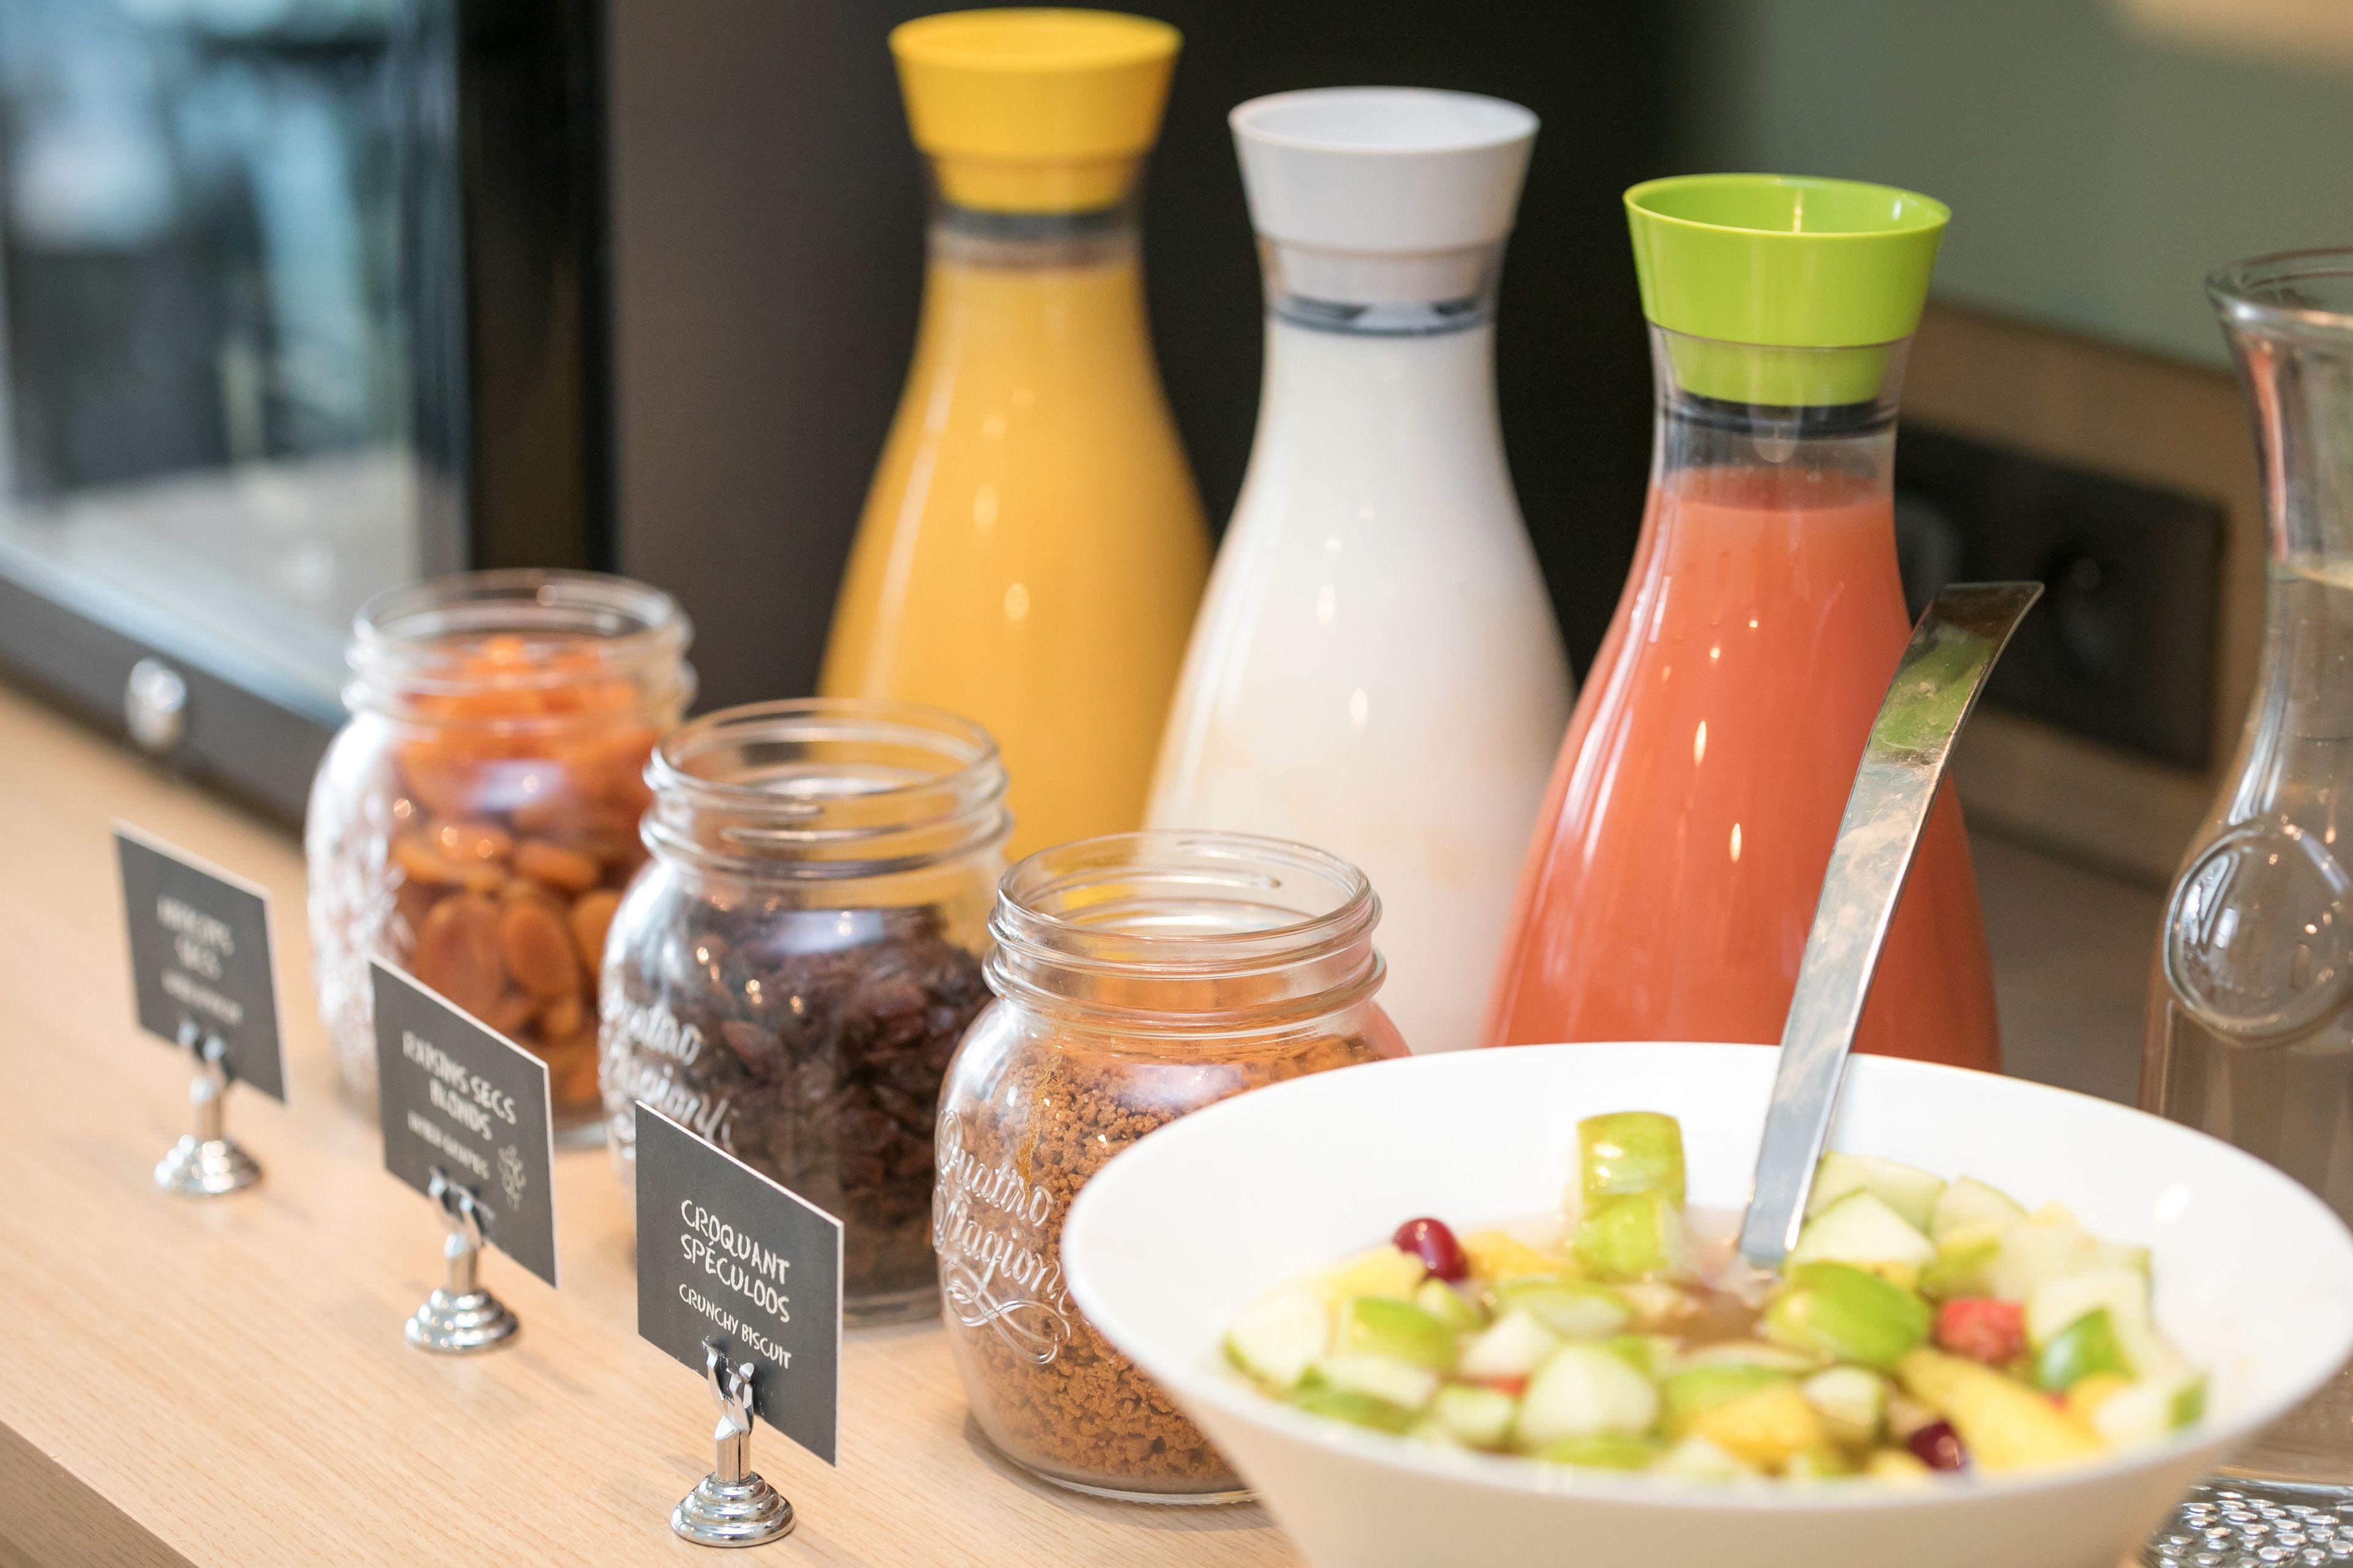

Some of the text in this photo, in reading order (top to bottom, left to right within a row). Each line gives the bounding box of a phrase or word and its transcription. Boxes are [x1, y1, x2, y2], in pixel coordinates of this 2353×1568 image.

[471, 1075, 517, 1125] SECS
[680, 1199, 791, 1285] CROQUANT
[680, 1233, 791, 1324] SPÉCULOOS
[678, 1283, 792, 1369] CRUNCHY BISCUIT
